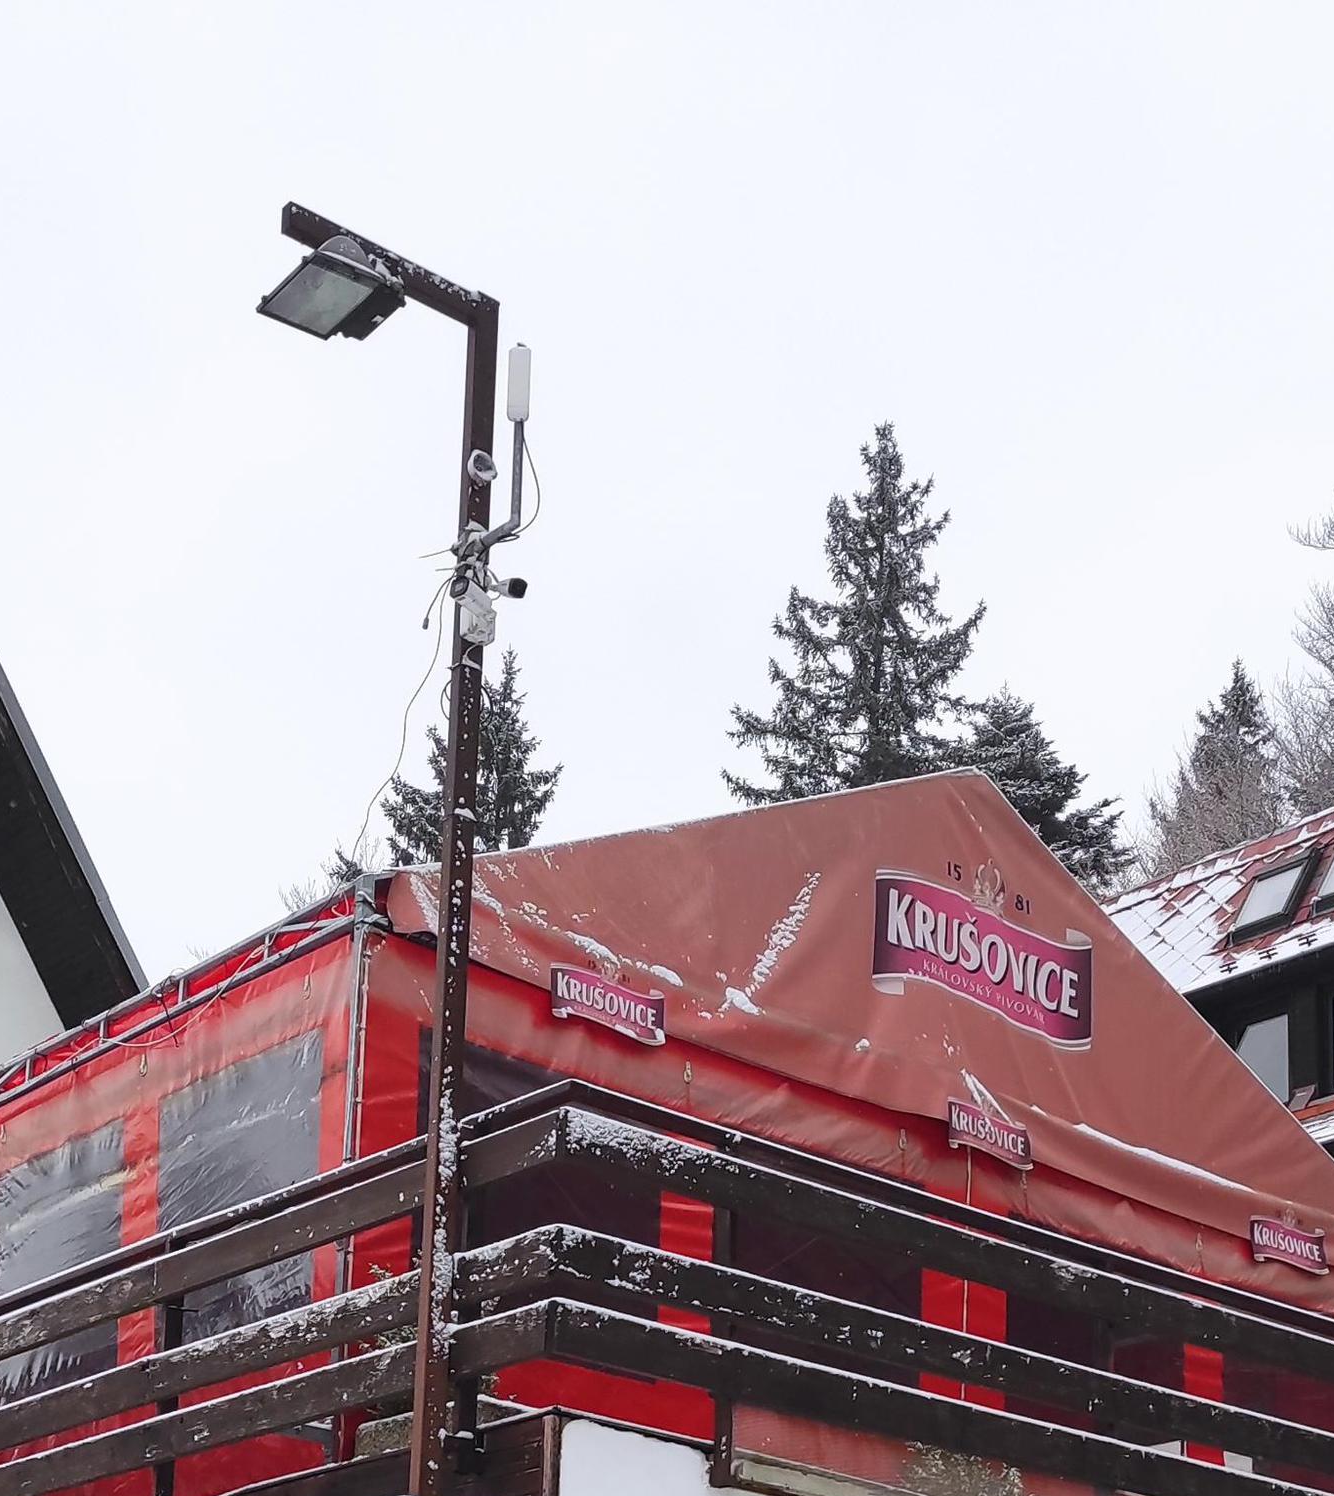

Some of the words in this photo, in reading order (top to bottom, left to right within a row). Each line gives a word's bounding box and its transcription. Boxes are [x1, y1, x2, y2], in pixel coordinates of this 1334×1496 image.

[946, 861, 962, 881] 15
[1014, 894, 1031, 915] 81
[886, 887, 1080, 1019] KRUŠOVICE
[557, 971, 657, 1030] KRUŠOVICE
[922, 958, 993, 999] KRÁLOVSKÝ
[995, 991, 1046, 1026] PIVOVAR
[1253, 1222, 1322, 1263] KRUŠOVICE
